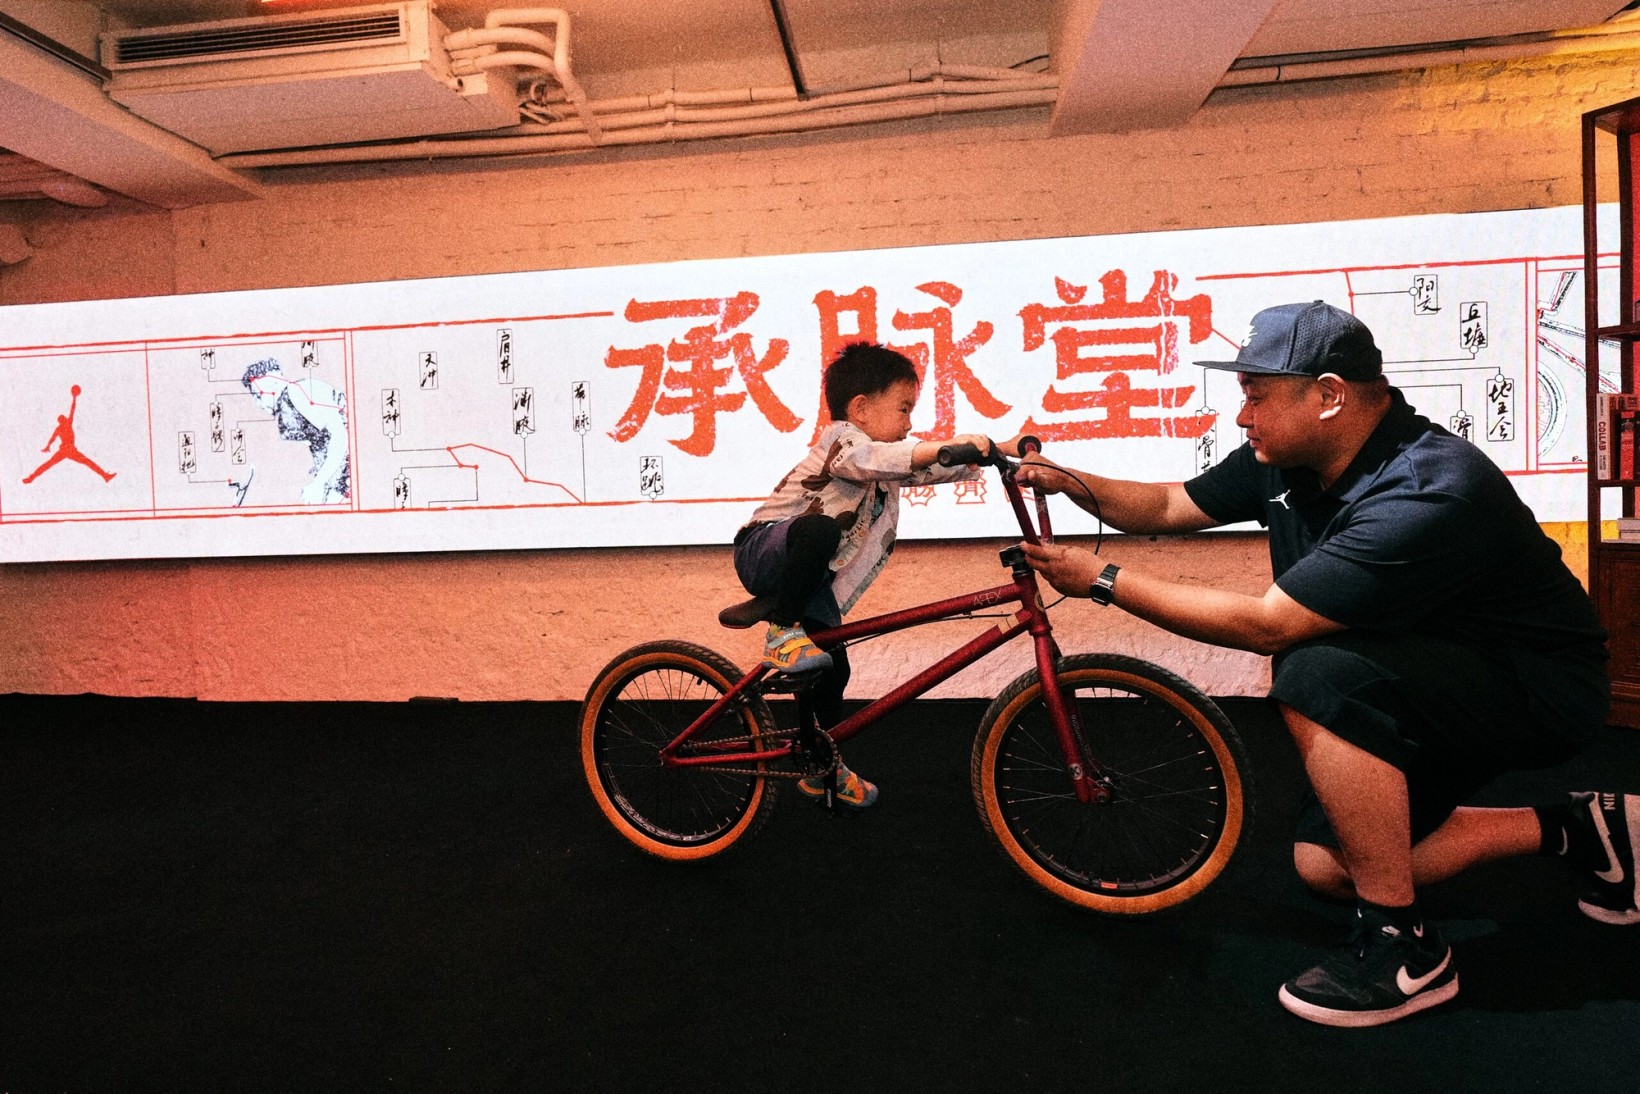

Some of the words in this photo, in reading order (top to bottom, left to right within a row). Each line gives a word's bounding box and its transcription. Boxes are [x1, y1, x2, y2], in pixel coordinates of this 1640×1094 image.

[603, 269, 1219, 457] 承脉堂
[1598, 421, 1607, 451] COLLAB
